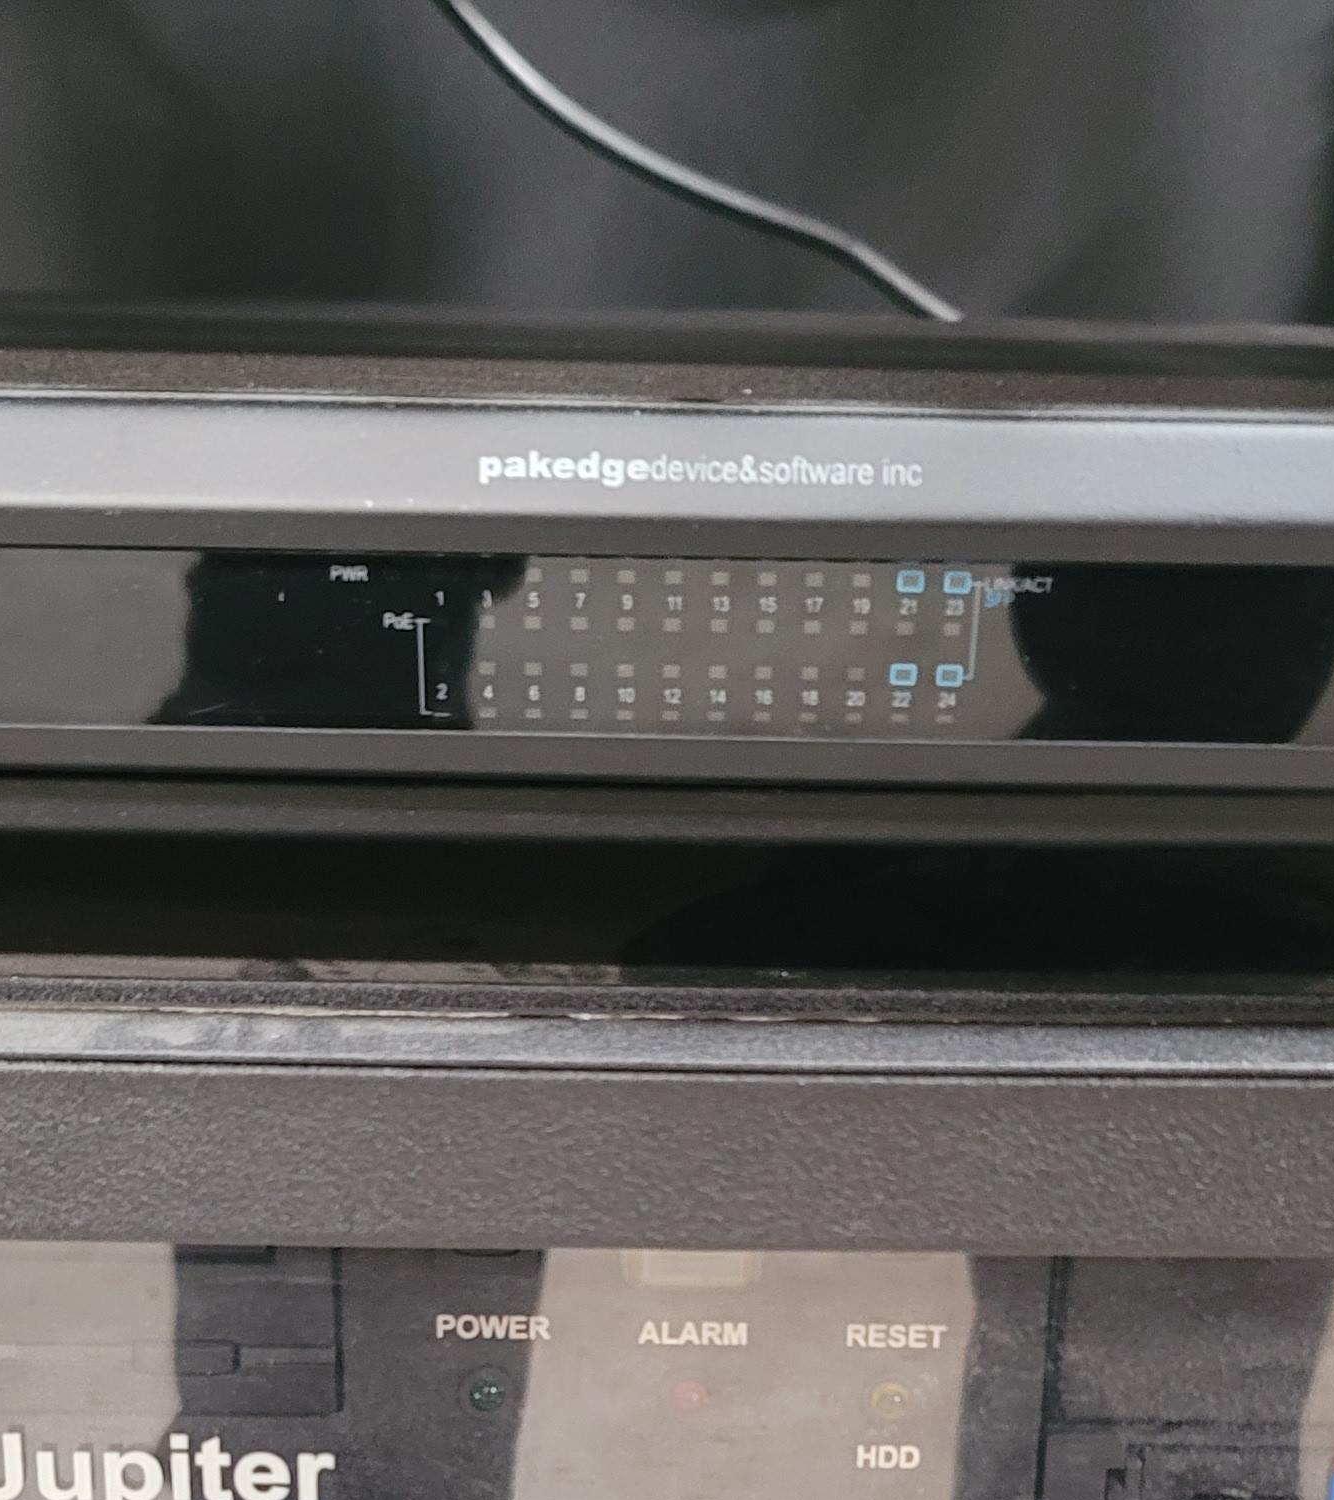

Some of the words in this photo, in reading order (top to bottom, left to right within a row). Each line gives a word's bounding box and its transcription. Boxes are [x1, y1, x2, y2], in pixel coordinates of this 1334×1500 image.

[478, 450, 874, 488] pakedgedevice&software
[882, 457, 923, 487] inc
[329, 564, 369, 582] PWR
[436, 591, 446, 606] 1
[527, 591, 541, 608] 5
[575, 592, 587, 609] 7
[621, 594, 634, 611] 9
[668, 595, 683, 611] 11
[759, 596, 779, 613] 15
[805, 597, 824, 613] 17
[382, 611, 415, 630] PoE
[435, 683, 448, 700] 2
[483, 685, 494, 699] 4
[528, 685, 540, 701] 6
[574, 686, 587, 702] 8
[663, 688, 683, 704] 12
[435, 1313, 552, 1341] POWER
[637, 1320, 749, 1346] ALARM
[845, 1324, 948, 1349] RESET
[855, 1444, 922, 1469] HDD
